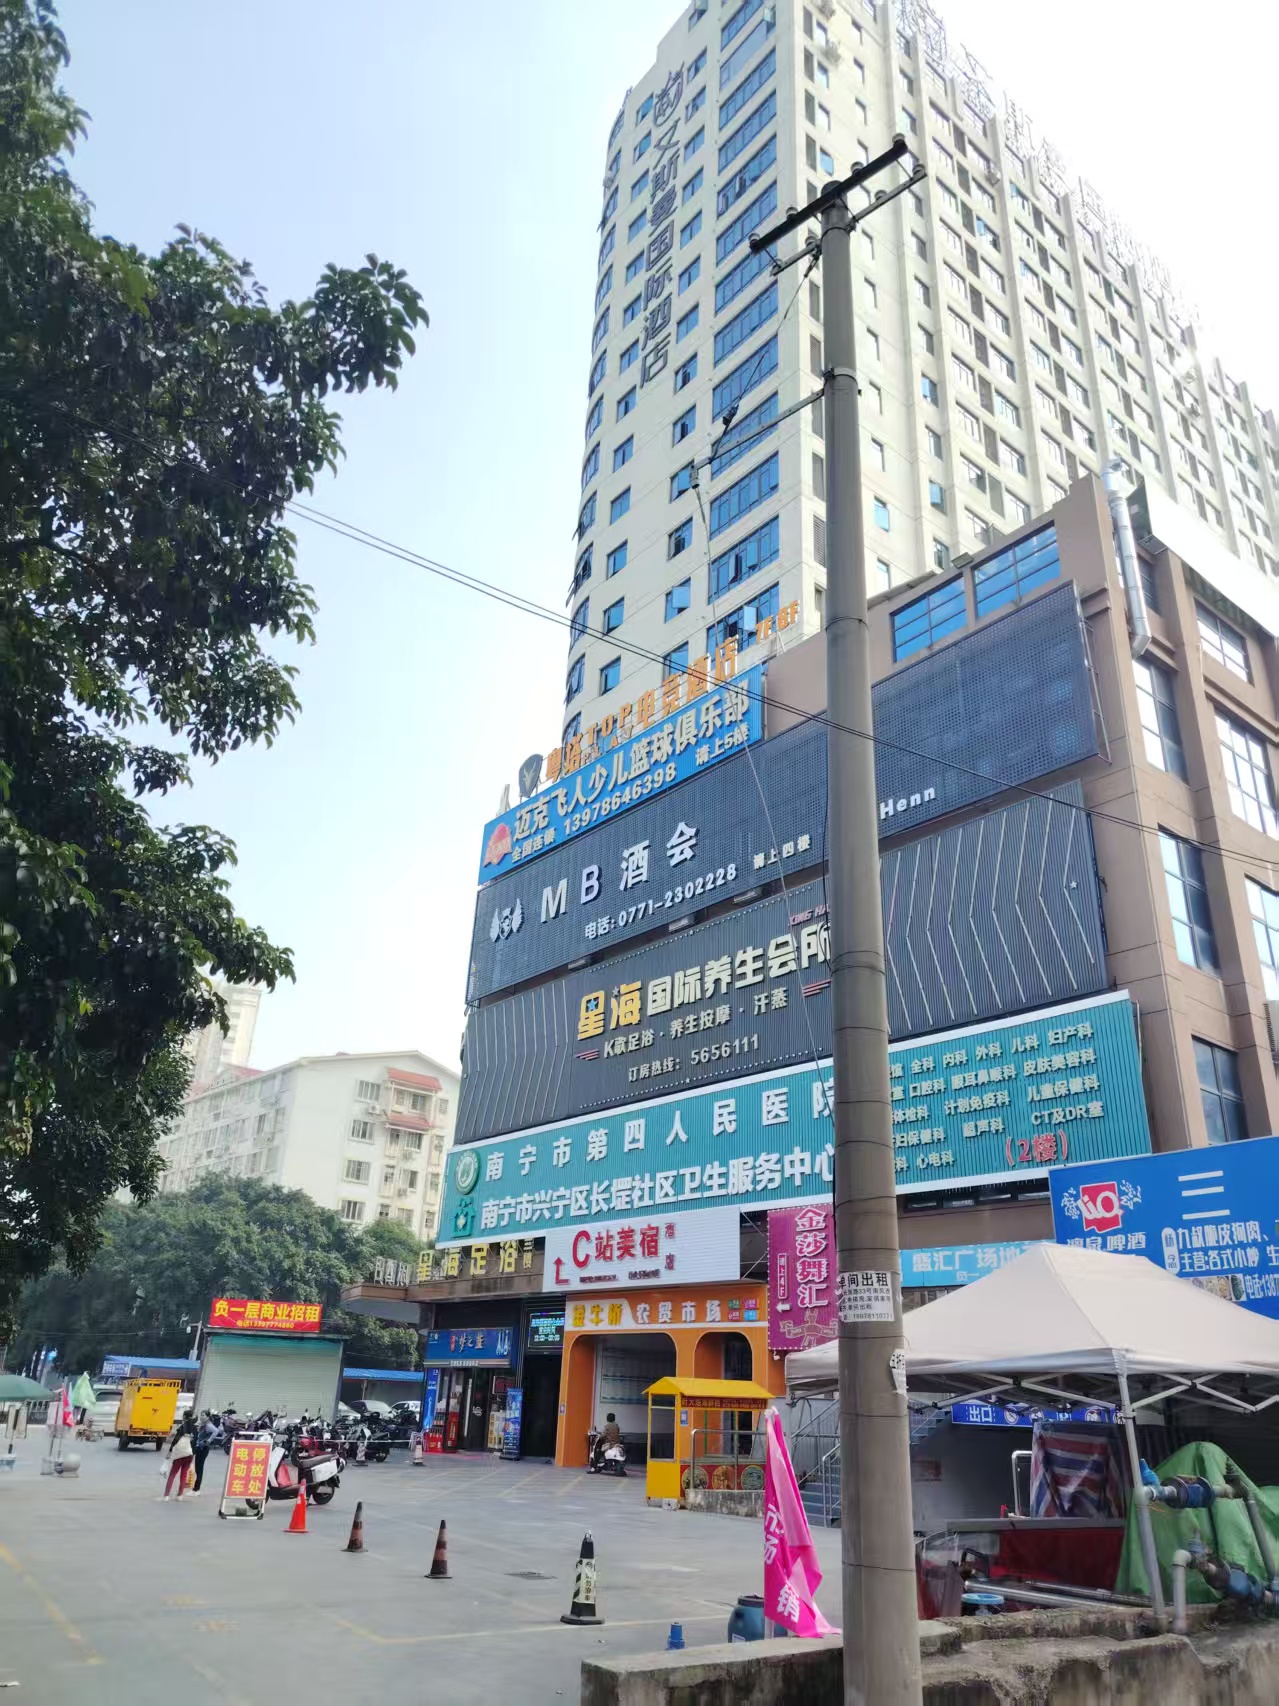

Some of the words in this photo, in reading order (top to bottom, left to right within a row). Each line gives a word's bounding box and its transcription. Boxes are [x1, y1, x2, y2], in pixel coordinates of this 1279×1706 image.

[513, 679, 749, 841] 迈克飞人少儿篮球俱乐部
[563, 761, 677, 836] 13978646398
[880, 787, 936, 820] Henn
[577, 920, 832, 1041] 星海国际养生会所
[690, 1033, 760, 1065] 5656111
[911, 1056, 935, 1074] 全科
[943, 1049, 968, 1068] 内科
[976, 1042, 1002, 1060] 外科
[1011, 1034, 1039, 1053] 儿科
[1048, 1022, 1094, 1045] 妇产科
[909, 1079, 946, 1098] 口腔科
[1023, 1047, 1096, 1076] 皮肤美容科
[944, 1090, 1010, 1115] 计划免疫科
[1028, 1074, 1100, 1102] 儿童保健科
[485, 1078, 834, 1182] 南宁市第四人民医院
[1031, 1101, 1104, 1125] CT及DR室
[917, 1150, 954, 1169] 心电科
[481, 1142, 834, 1232] 南宁市兴宁区长堽社区卫生服务中心
[572, 1224, 660, 1269] C站美宿
[795, 1207, 829, 1308] 金莎舞汇
[214, 1300, 321, 1323] 负一层商业招租
[636, 1299, 722, 1324] 农贸市场
[969, 1405, 993, 1422] 出口
[231, 1448, 249, 1494] 电动车
[248, 1447, 266, 1494] 停放处
